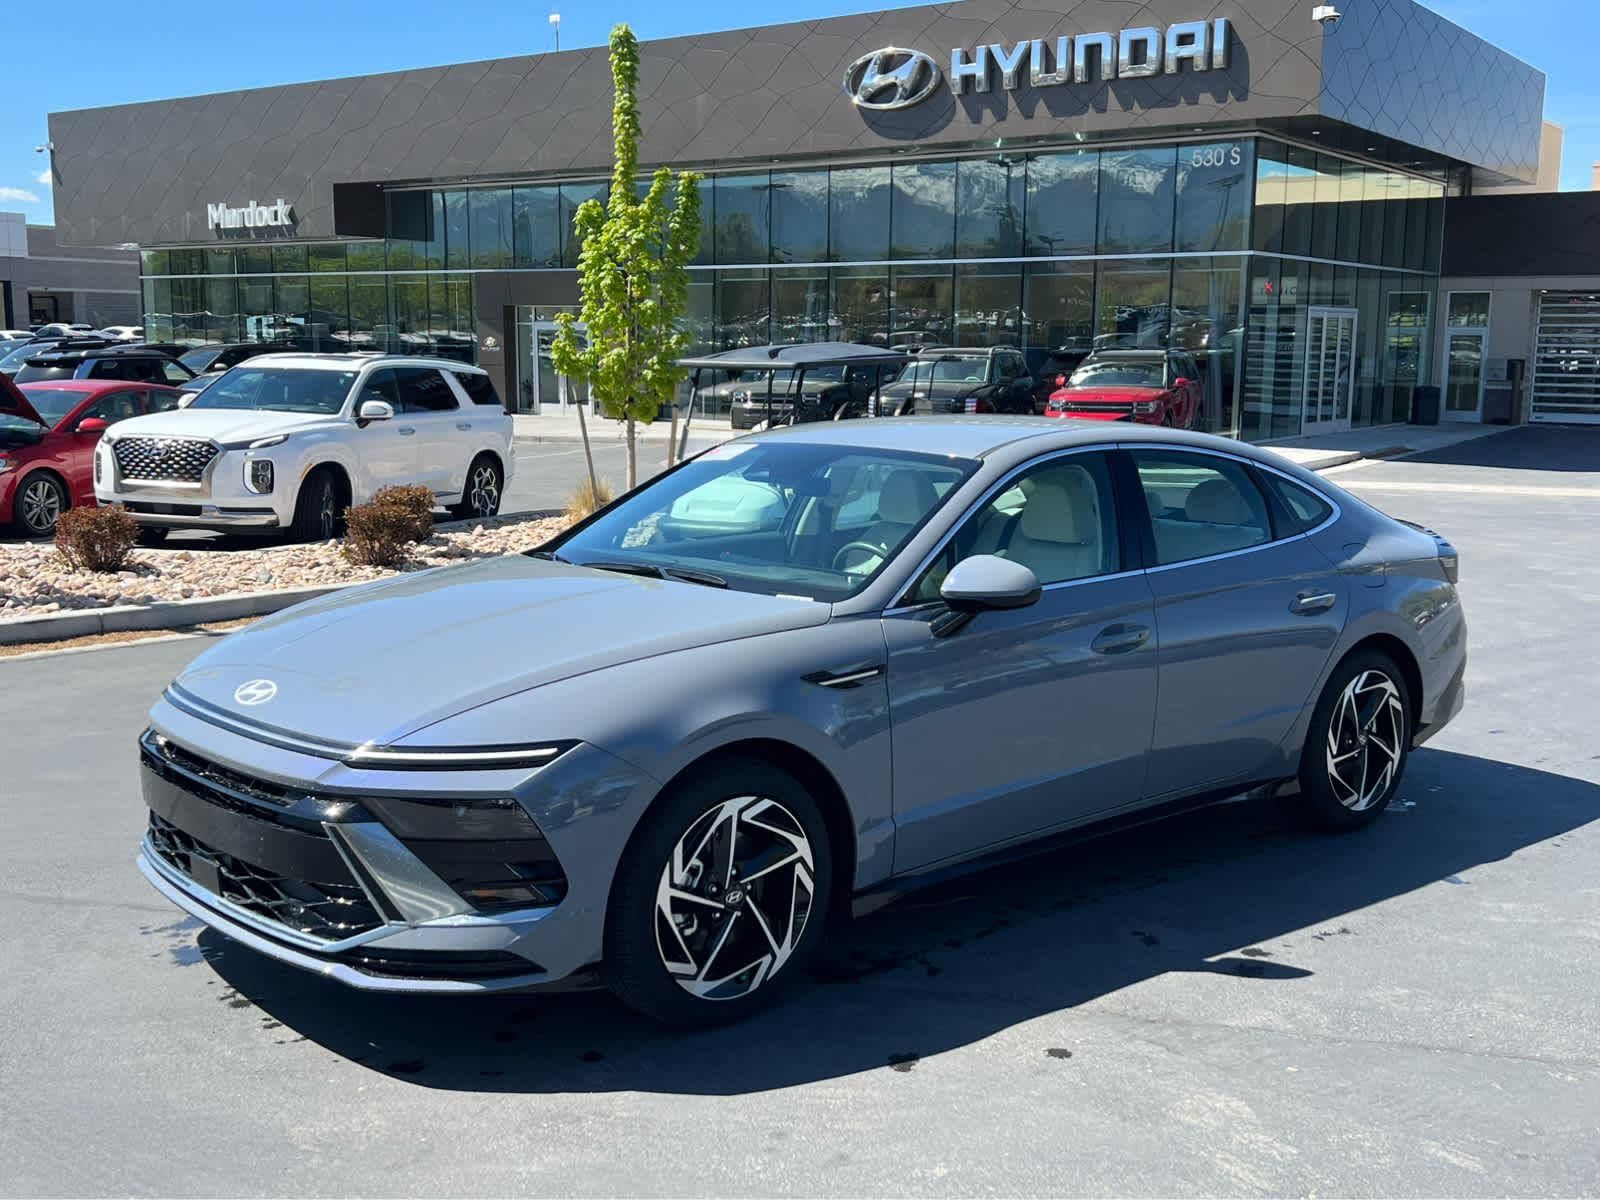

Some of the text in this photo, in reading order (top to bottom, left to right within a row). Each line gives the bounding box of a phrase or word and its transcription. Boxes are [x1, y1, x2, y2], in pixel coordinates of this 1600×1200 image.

[951, 17, 1231, 95] HYUNDAI
[1192, 145, 1241, 167] 530 S
[207, 198, 293, 231] Murdock
